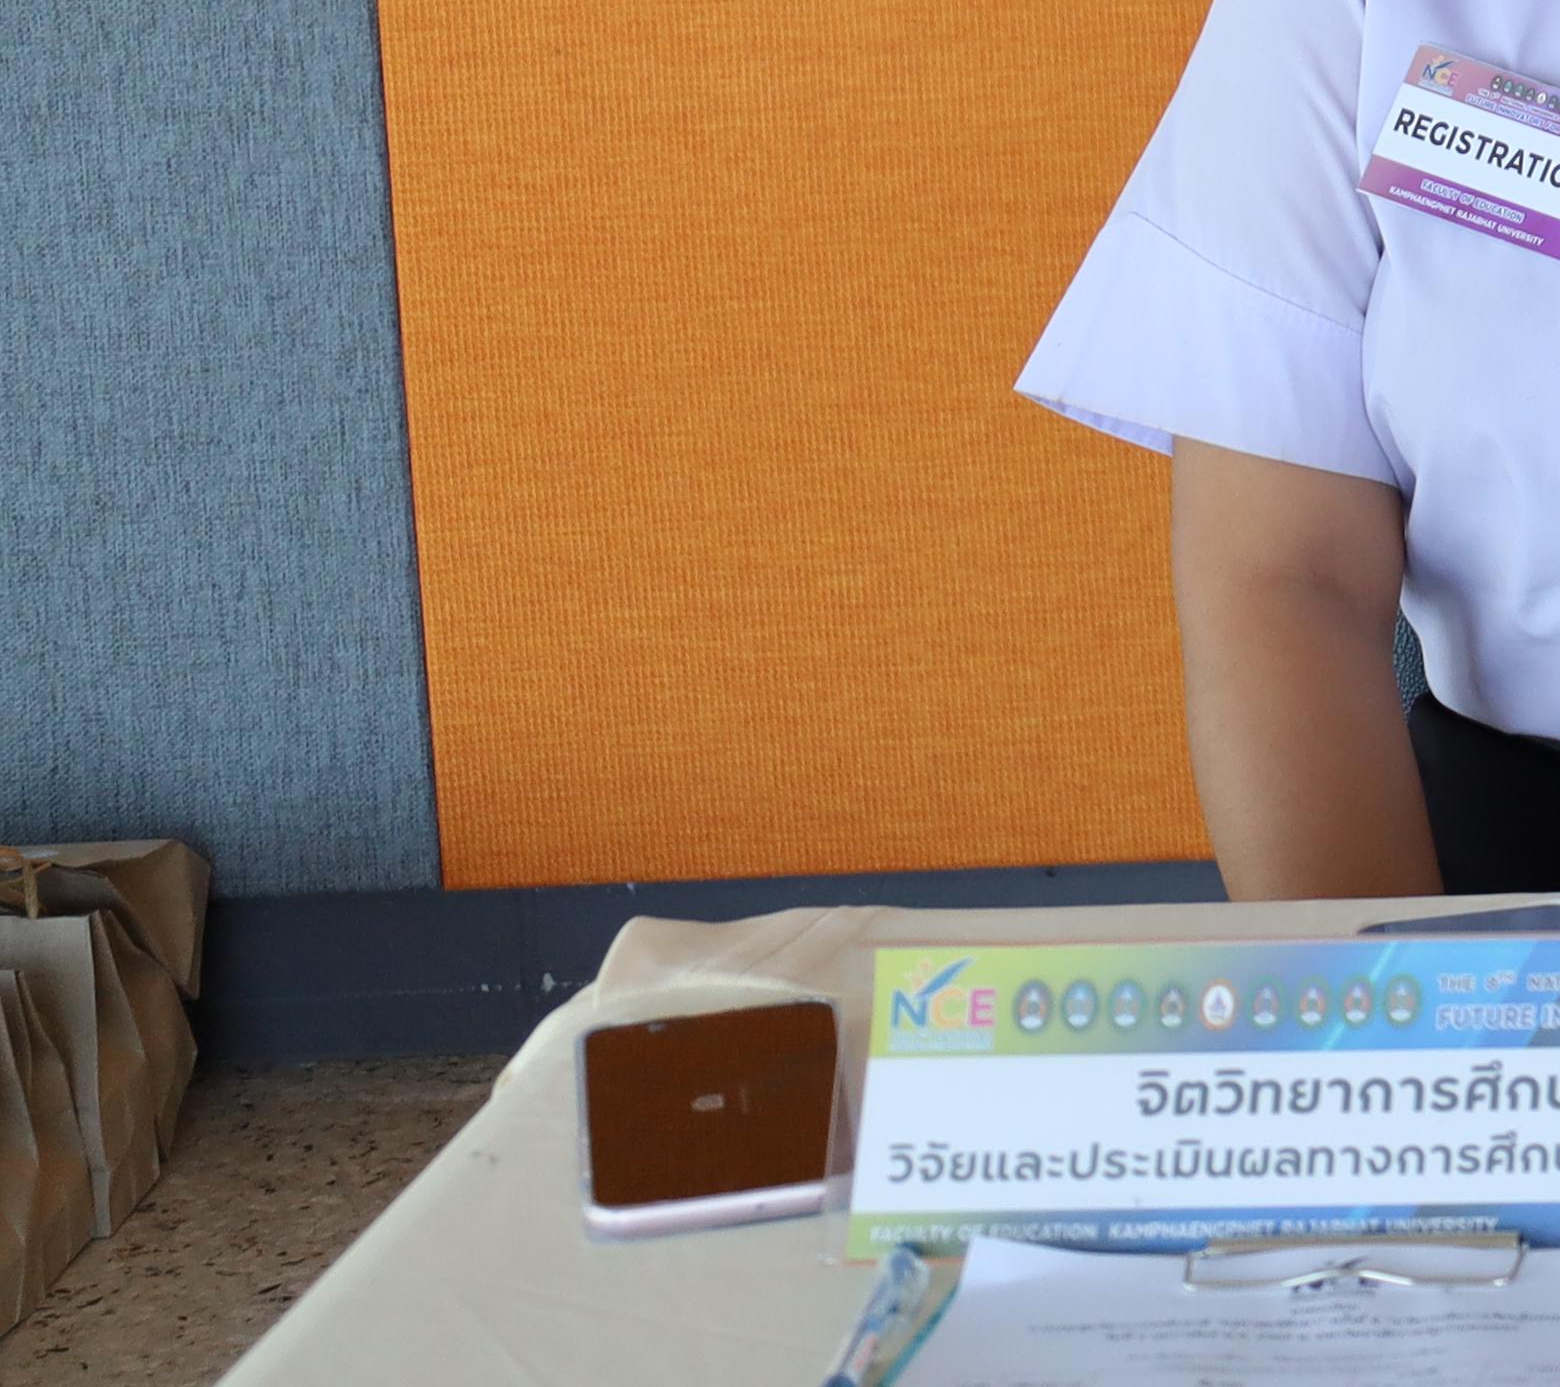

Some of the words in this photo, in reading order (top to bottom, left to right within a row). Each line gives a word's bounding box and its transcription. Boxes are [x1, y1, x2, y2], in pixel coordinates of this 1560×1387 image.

[1473, 196, 1526, 224] EDUCATION
[1498, 223, 1545, 247] UNIVERSITY
[1438, 974, 1475, 992] THE
[890, 988, 996, 1028] NCE
[1437, 1003, 1535, 1030] FUTURE
